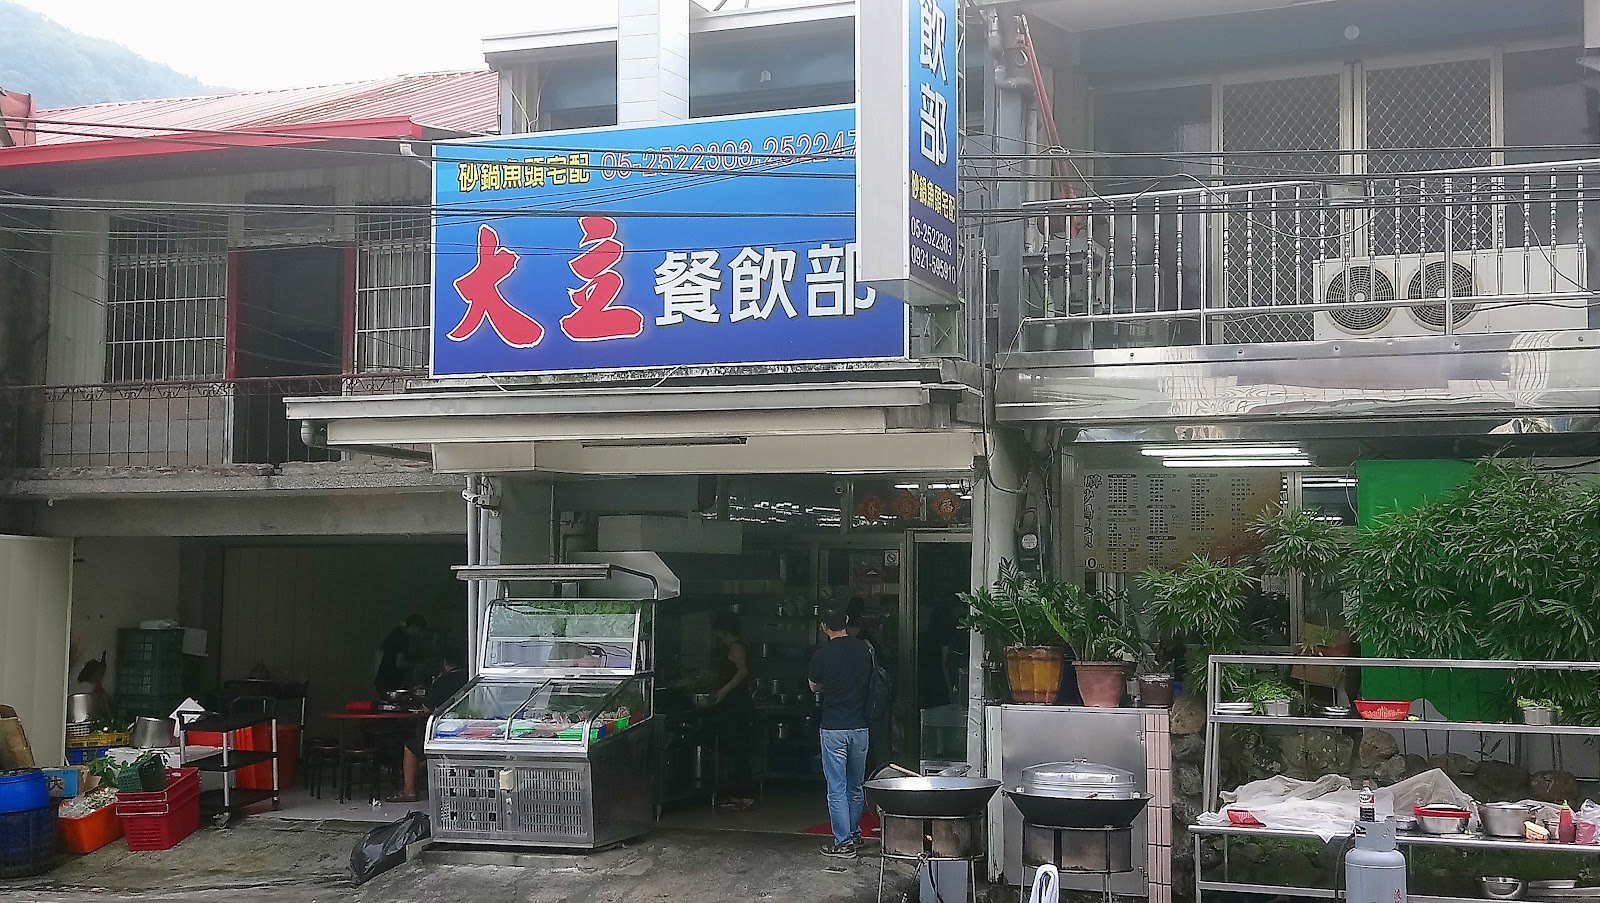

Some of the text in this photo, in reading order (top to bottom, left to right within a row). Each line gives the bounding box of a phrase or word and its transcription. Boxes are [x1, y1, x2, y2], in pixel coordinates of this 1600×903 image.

[458, 153, 590, 192] 砂鍋魚頭宅配
[911, 170, 956, 223] 砂鍋魚頭宅配
[911, 216, 952, 256] 05-2522303
[911, 244, 957, 284] 0921-595910
